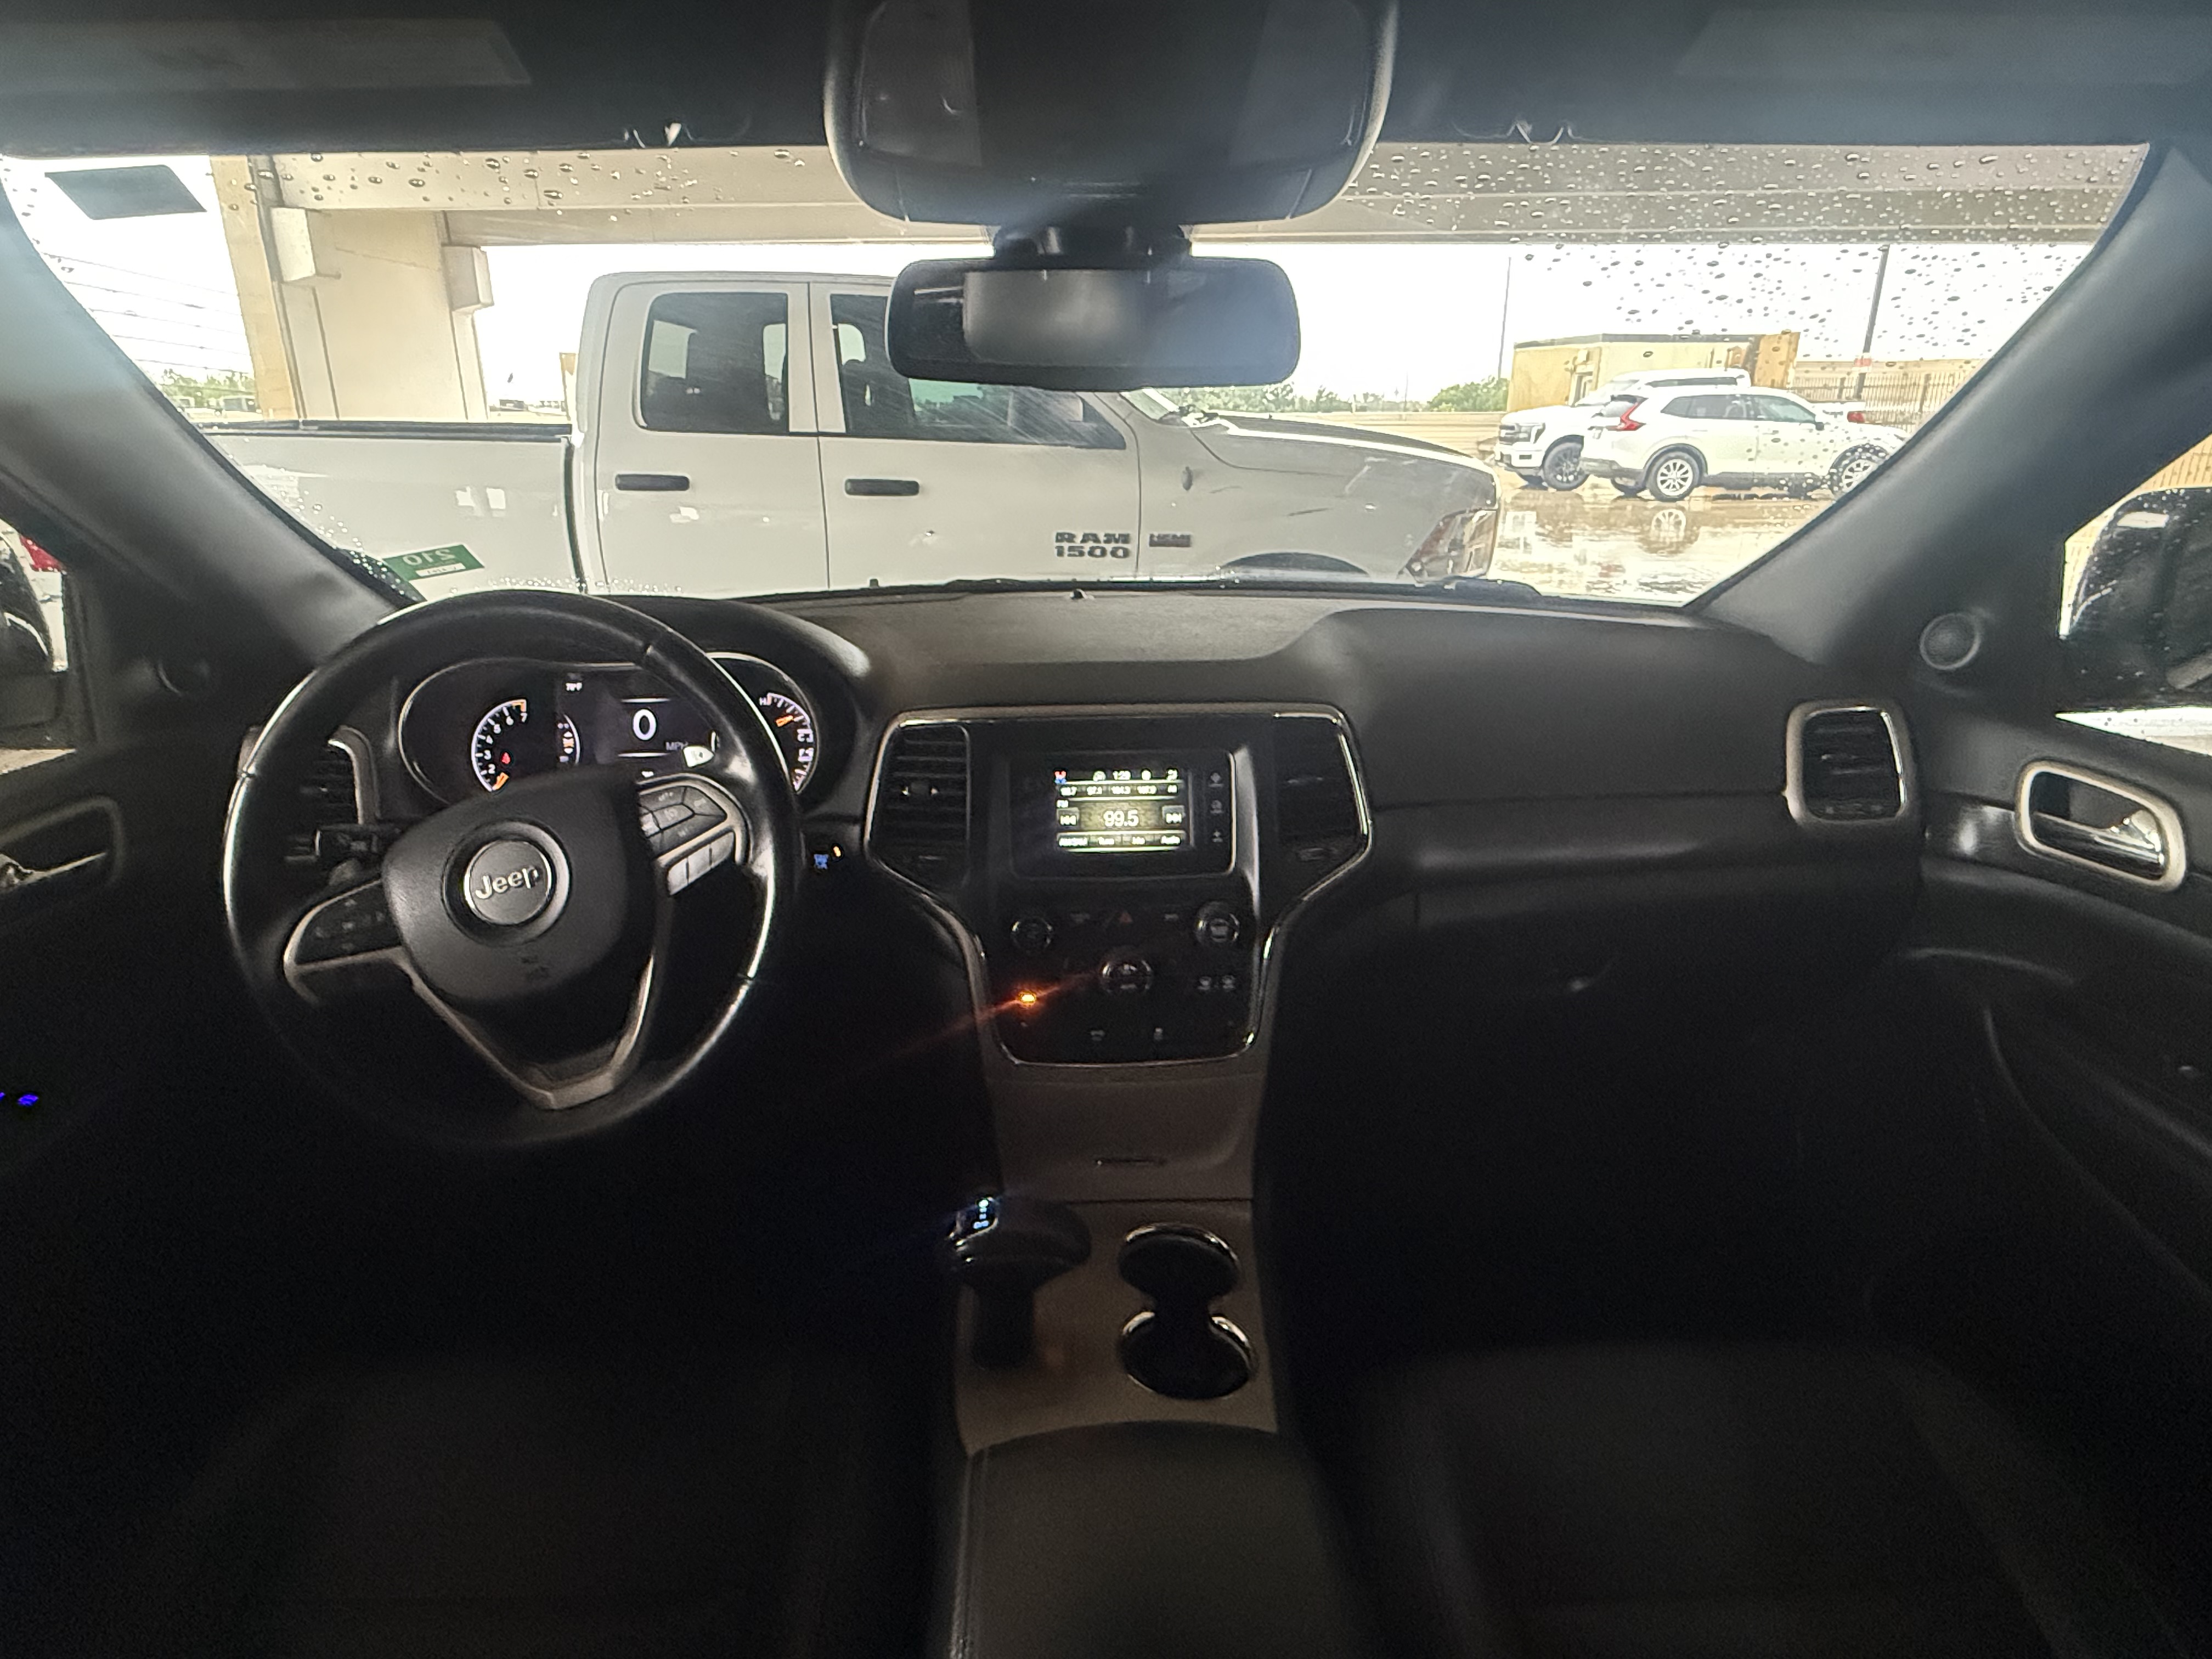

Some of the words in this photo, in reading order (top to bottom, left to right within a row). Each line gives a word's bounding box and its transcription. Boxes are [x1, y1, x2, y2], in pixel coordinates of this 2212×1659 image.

[1055, 532, 1130, 544] RAM
[1054, 545, 1131, 558] 1500
[520, 713, 528, 723] 7
[633, 709, 657, 741] 0
[484, 750, 492, 760] 3
[488, 764, 496, 774] 2
[1103, 809, 1139, 827] 99.5
[474, 865, 540, 899] Jeep
